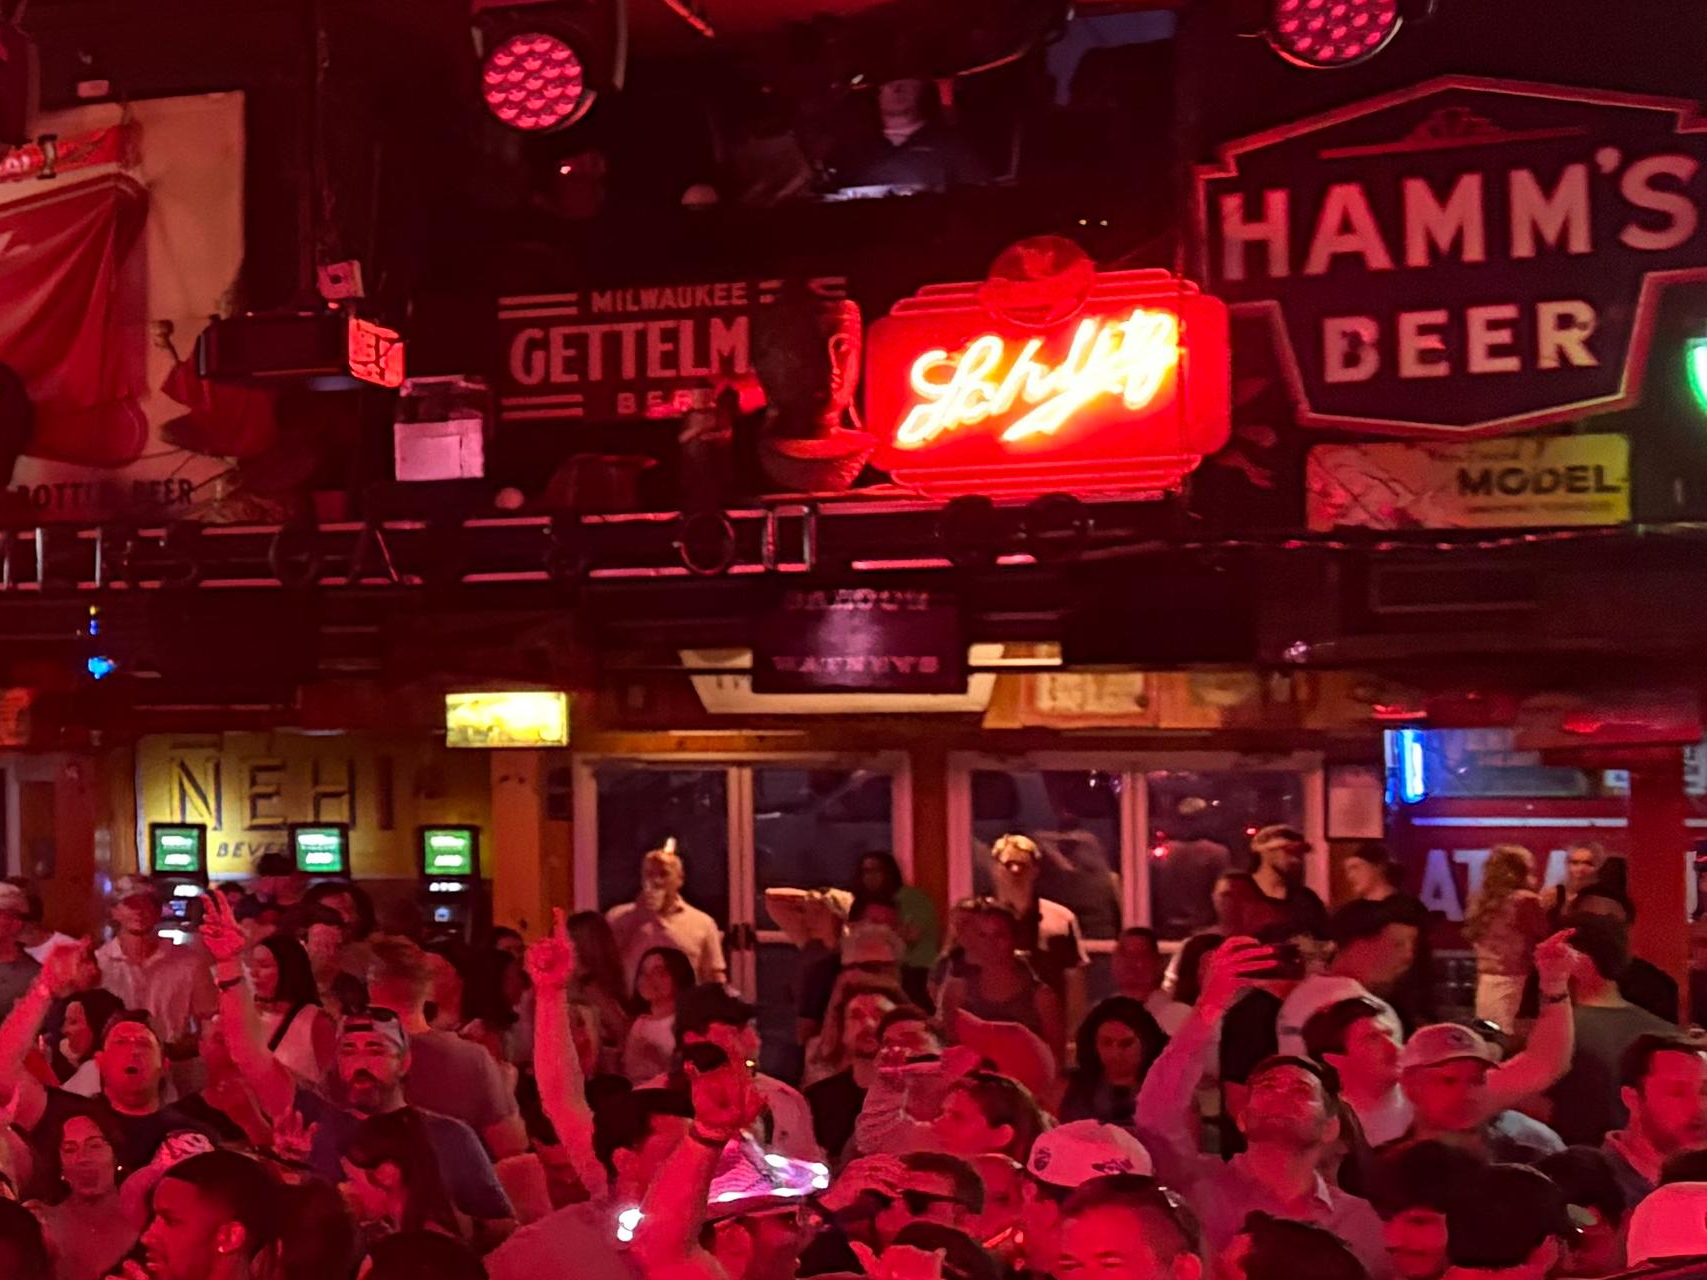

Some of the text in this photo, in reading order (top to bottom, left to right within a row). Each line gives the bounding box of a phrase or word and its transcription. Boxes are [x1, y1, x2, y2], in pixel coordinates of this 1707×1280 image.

[1219, 144, 1702, 283] HAMM'S
[590, 281, 748, 314] MILWAUKEE
[509, 316, 751, 386] GETTELM
[1324, 300, 1601, 384] BEER
[1456, 463, 1622, 498] MODEL
[169, 753, 397, 833] NEHI
